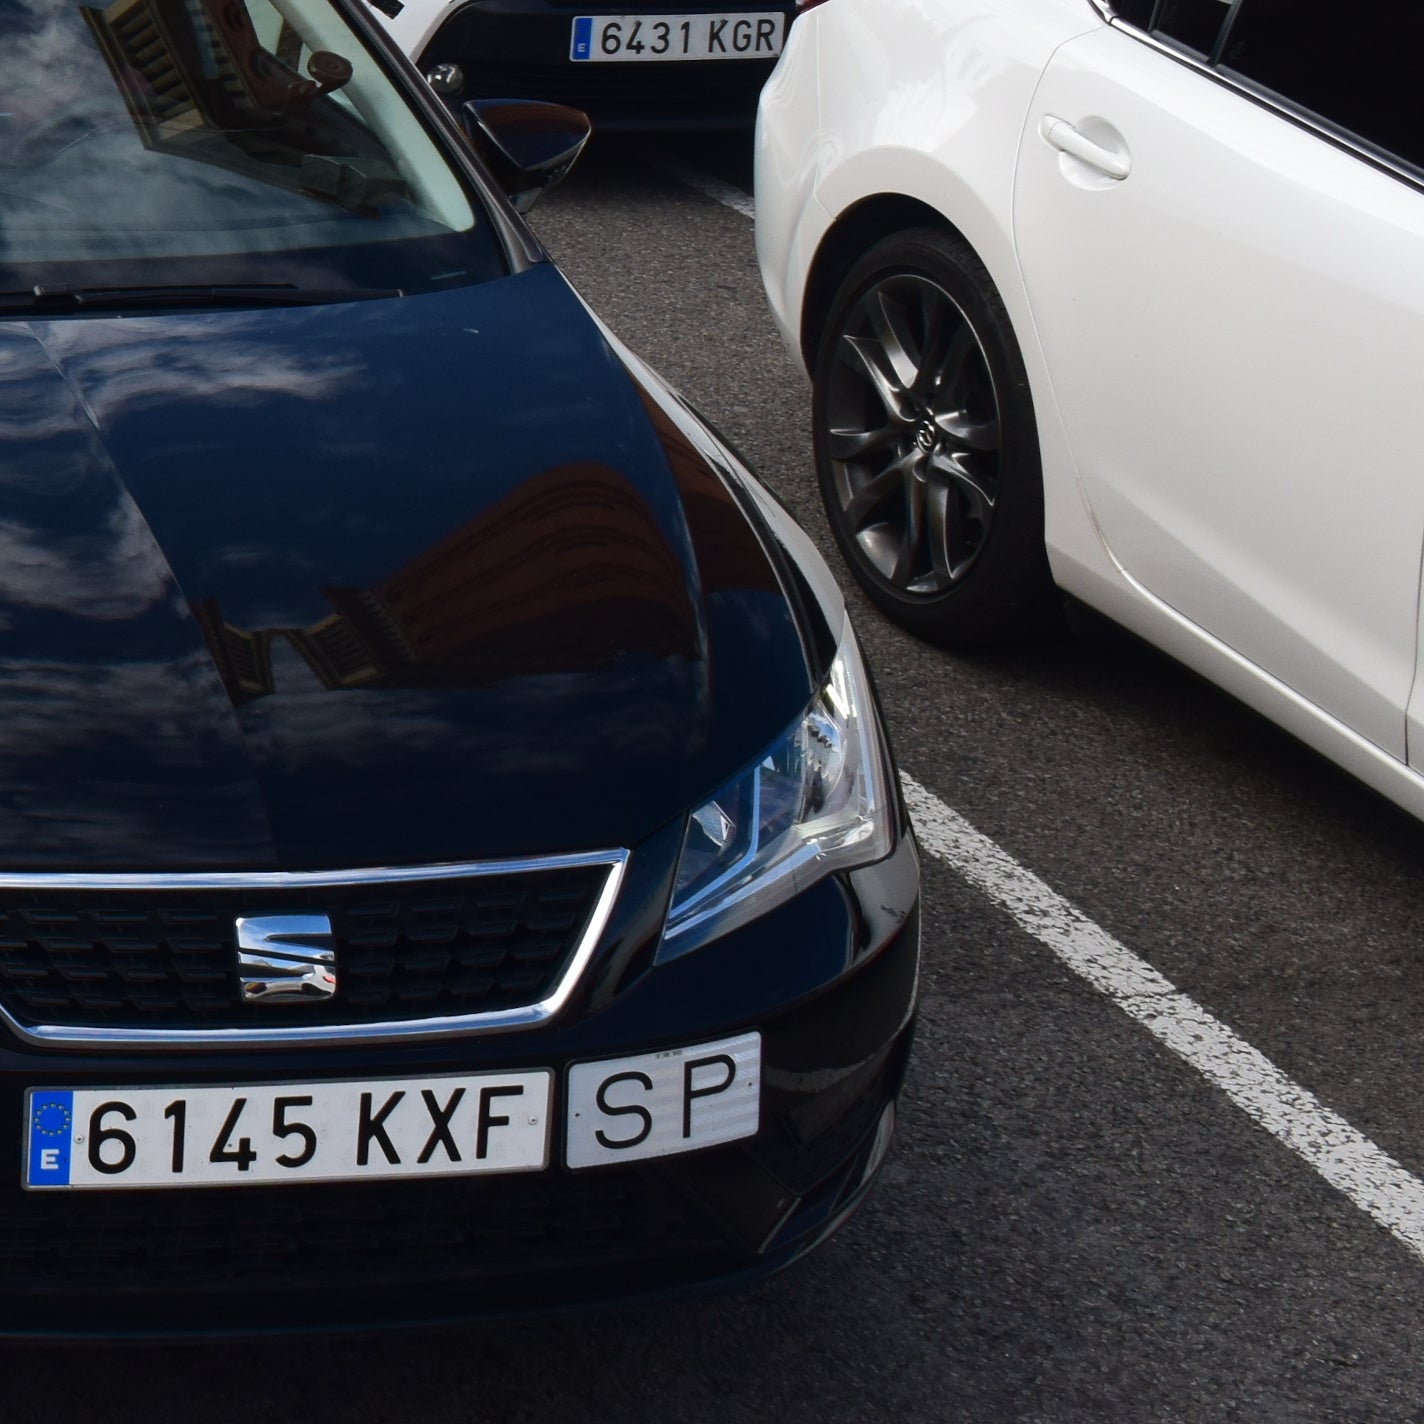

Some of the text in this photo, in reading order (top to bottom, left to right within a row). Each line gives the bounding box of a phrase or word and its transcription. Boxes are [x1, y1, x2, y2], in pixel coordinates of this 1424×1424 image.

[577, 19, 775, 55] E 6431 KGR
[41, 1053, 736, 1175] E 6145 KXF SP
